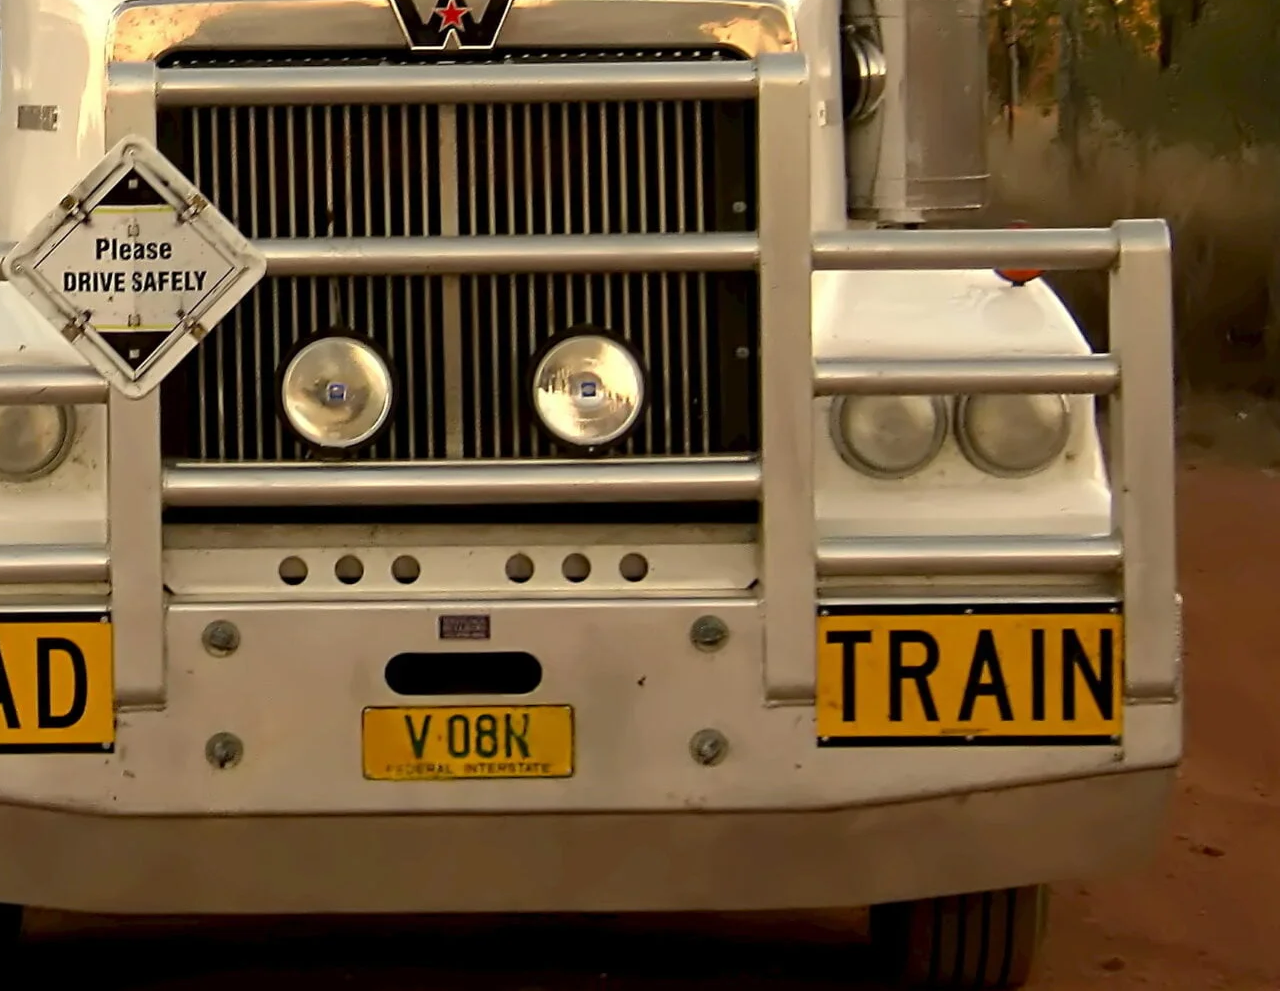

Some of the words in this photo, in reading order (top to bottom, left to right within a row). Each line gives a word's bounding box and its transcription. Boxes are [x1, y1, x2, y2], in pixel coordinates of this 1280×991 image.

[95, 238, 173, 260] Please
[63, 271, 125, 292] DRIVE
[131, 270, 207, 291] SAFELY
[826, 628, 1114, 722] TRAIN
[385, 763, 453, 775] FEDERAL
[463, 762, 551, 774] INTERSTATE
